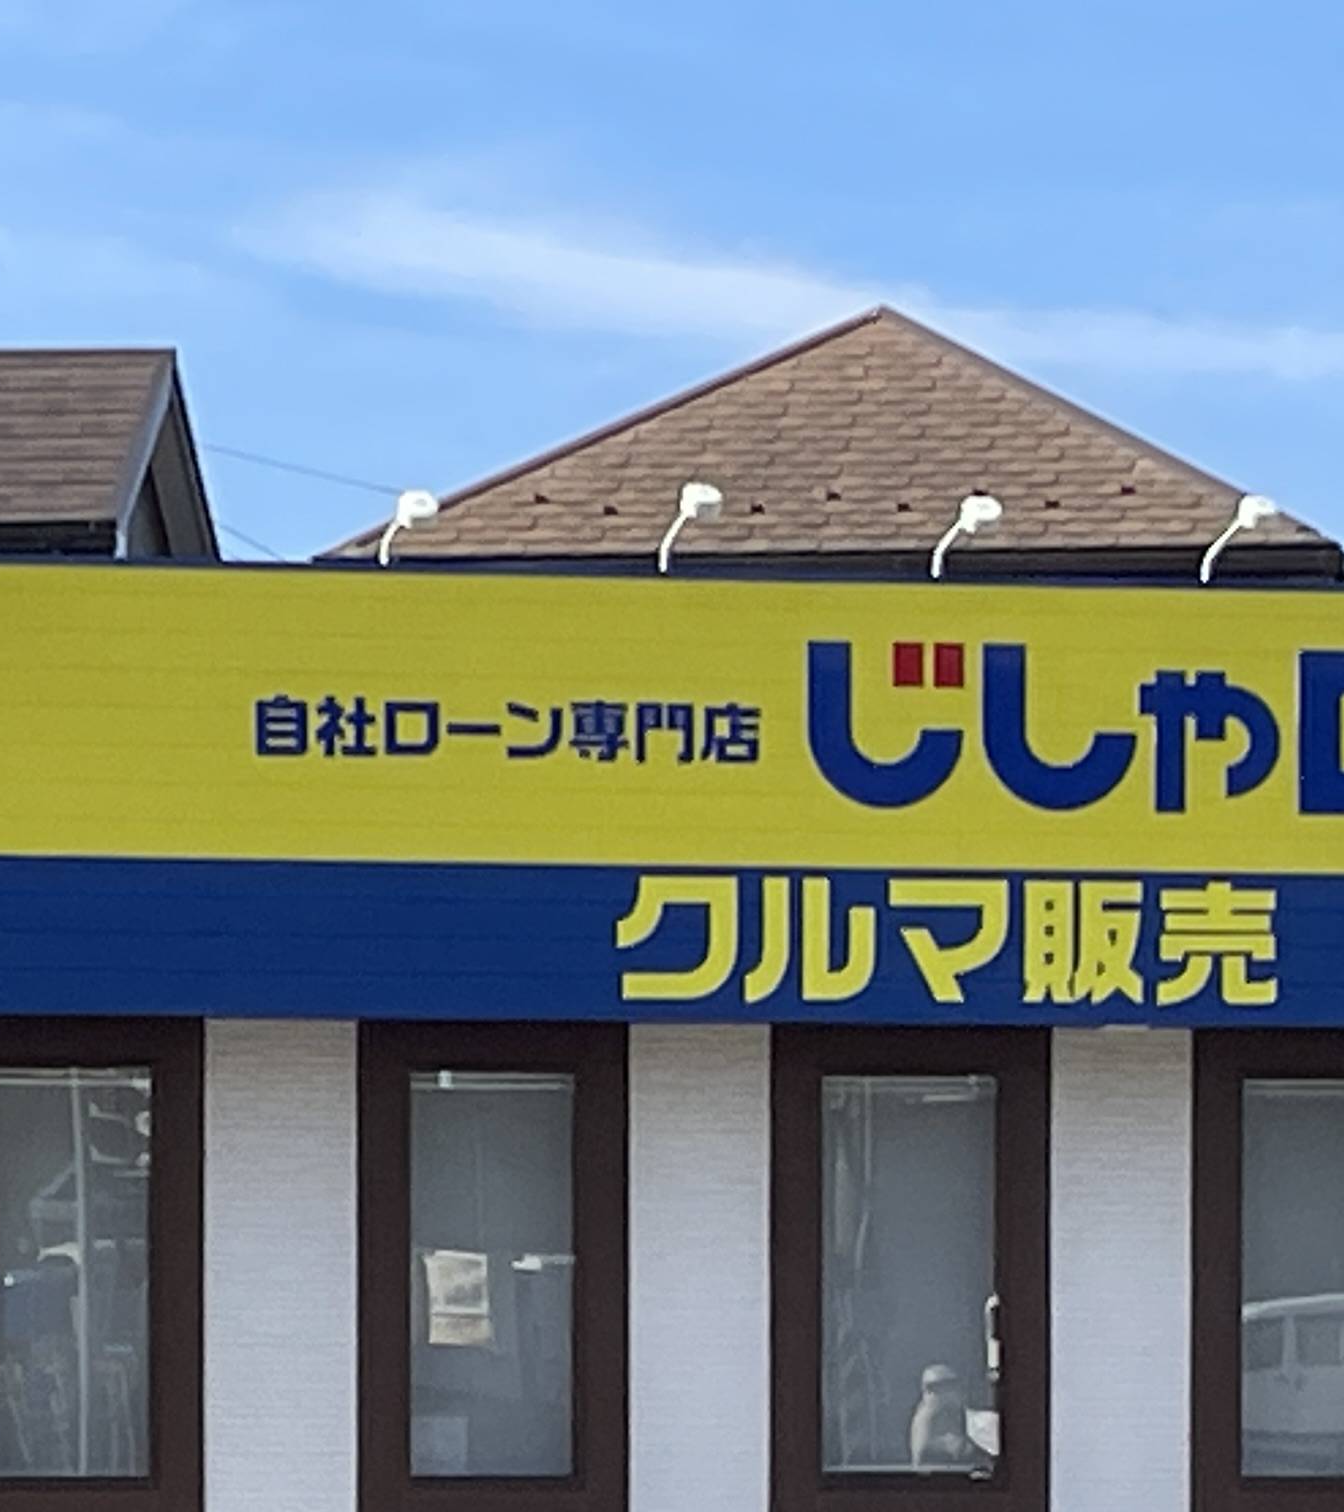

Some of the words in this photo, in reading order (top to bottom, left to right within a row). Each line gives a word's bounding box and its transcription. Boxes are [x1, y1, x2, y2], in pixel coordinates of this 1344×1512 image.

[253, 693, 761, 764] 自社ローン専門店
[617, 875, 1277, 1004] クルマ販売
